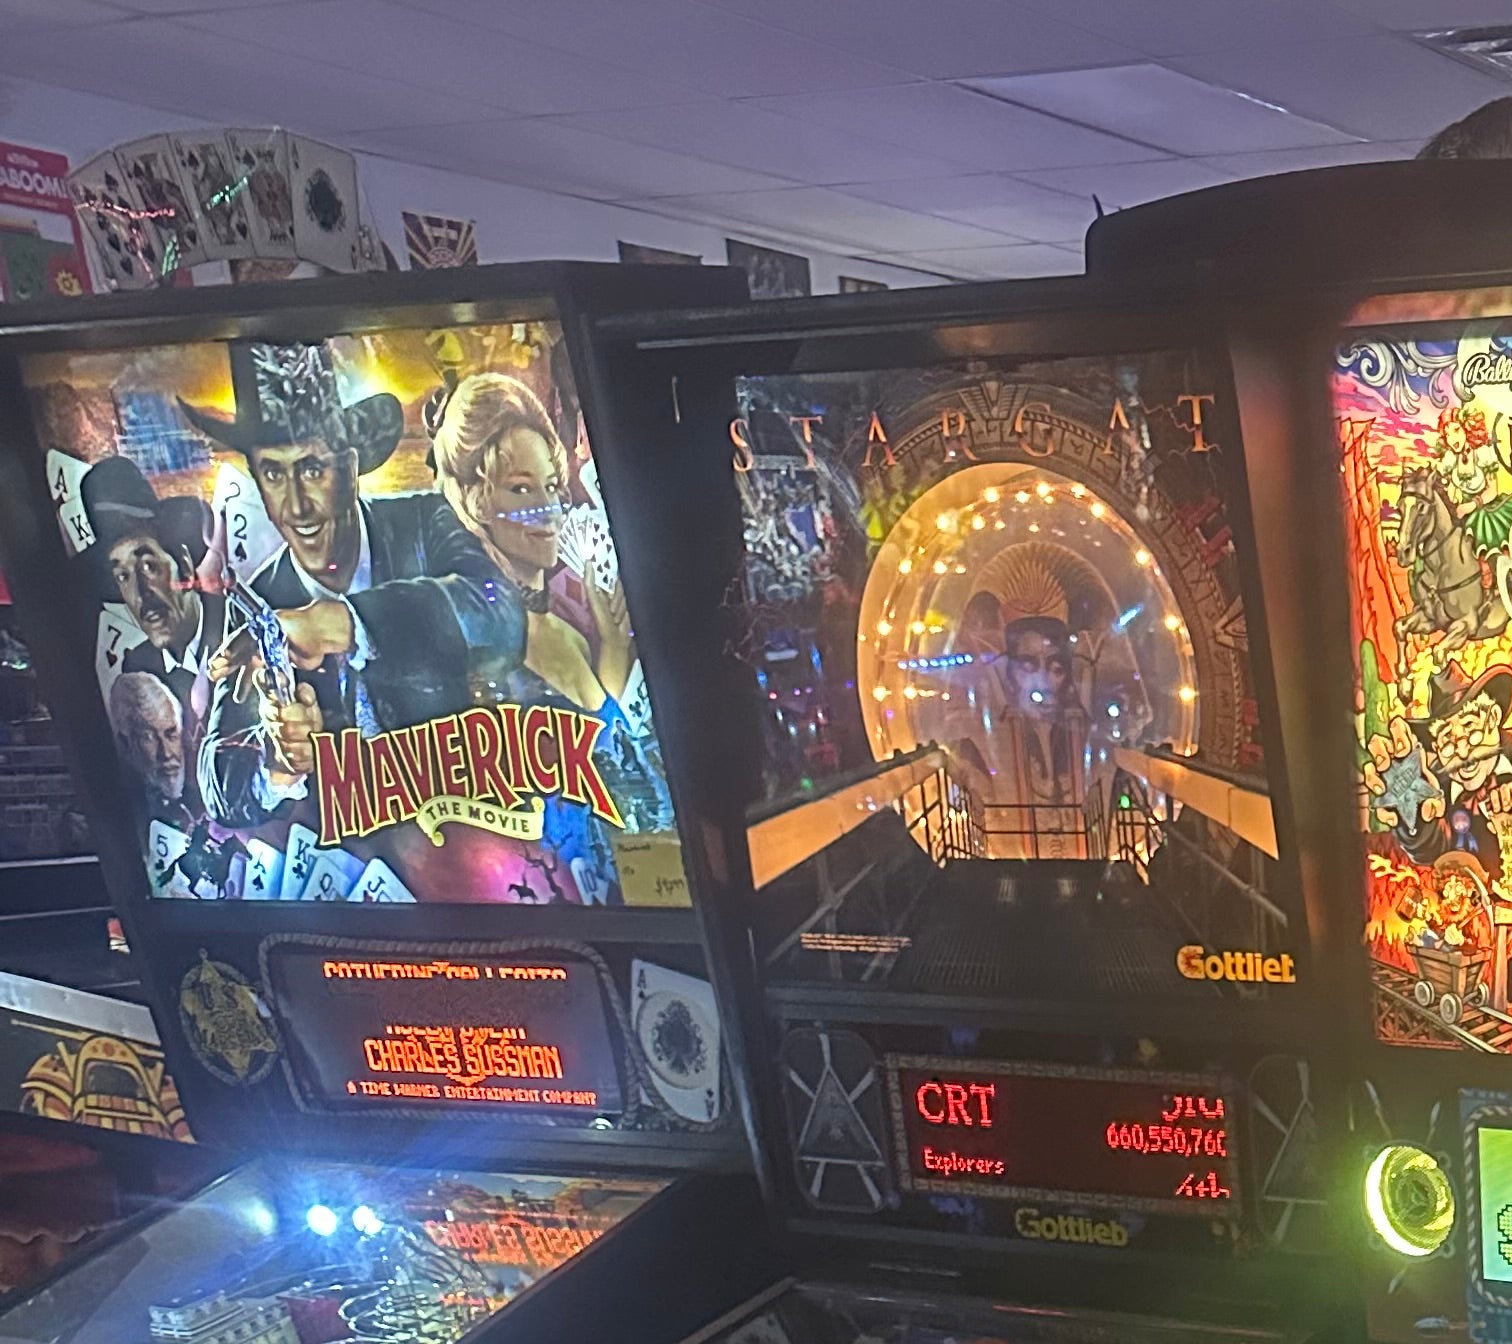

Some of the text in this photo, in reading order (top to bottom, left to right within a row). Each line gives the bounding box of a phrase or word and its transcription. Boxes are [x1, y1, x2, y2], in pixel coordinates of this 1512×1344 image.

[311, 703, 627, 846] MAVERICK
[427, 801, 530, 834] THE MOVIE
[364, 1037, 563, 1079] CHARLES SUSSMAN
[444, 1085, 541, 1103] ENTERTAINMENT
[916, 1080, 995, 1127] CRT
[923, 1146, 1006, 1176] Explorers
[1015, 1207, 1129, 1246] Gottlieb
